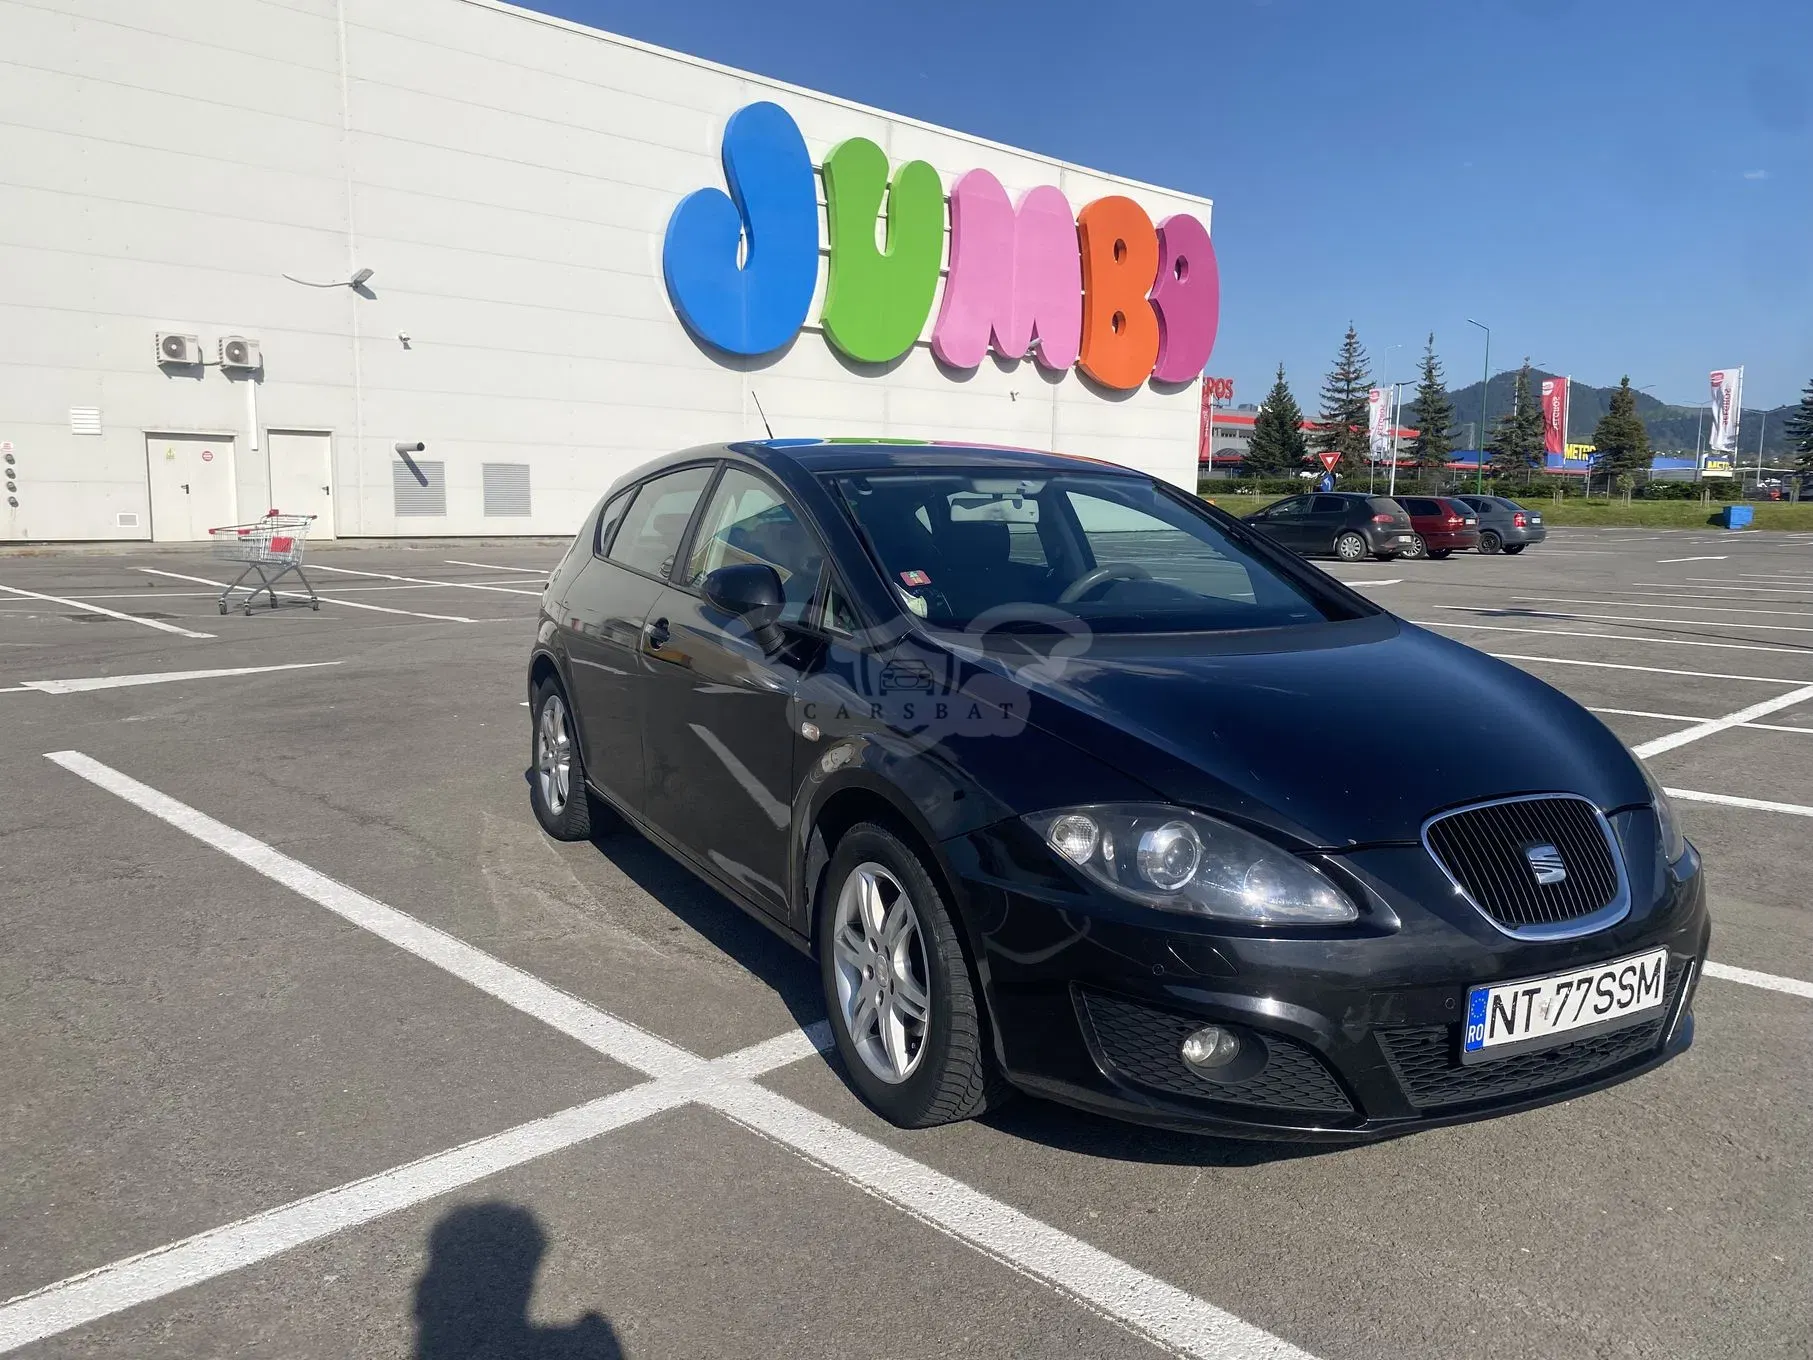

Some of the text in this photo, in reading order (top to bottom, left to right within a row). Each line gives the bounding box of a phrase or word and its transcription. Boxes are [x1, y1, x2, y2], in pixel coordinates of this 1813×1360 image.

[663, 101, 1219, 389] JUMBO
[1468, 1024, 1484, 1043] RO
[1489, 957, 1662, 1039] NT 77SSM
